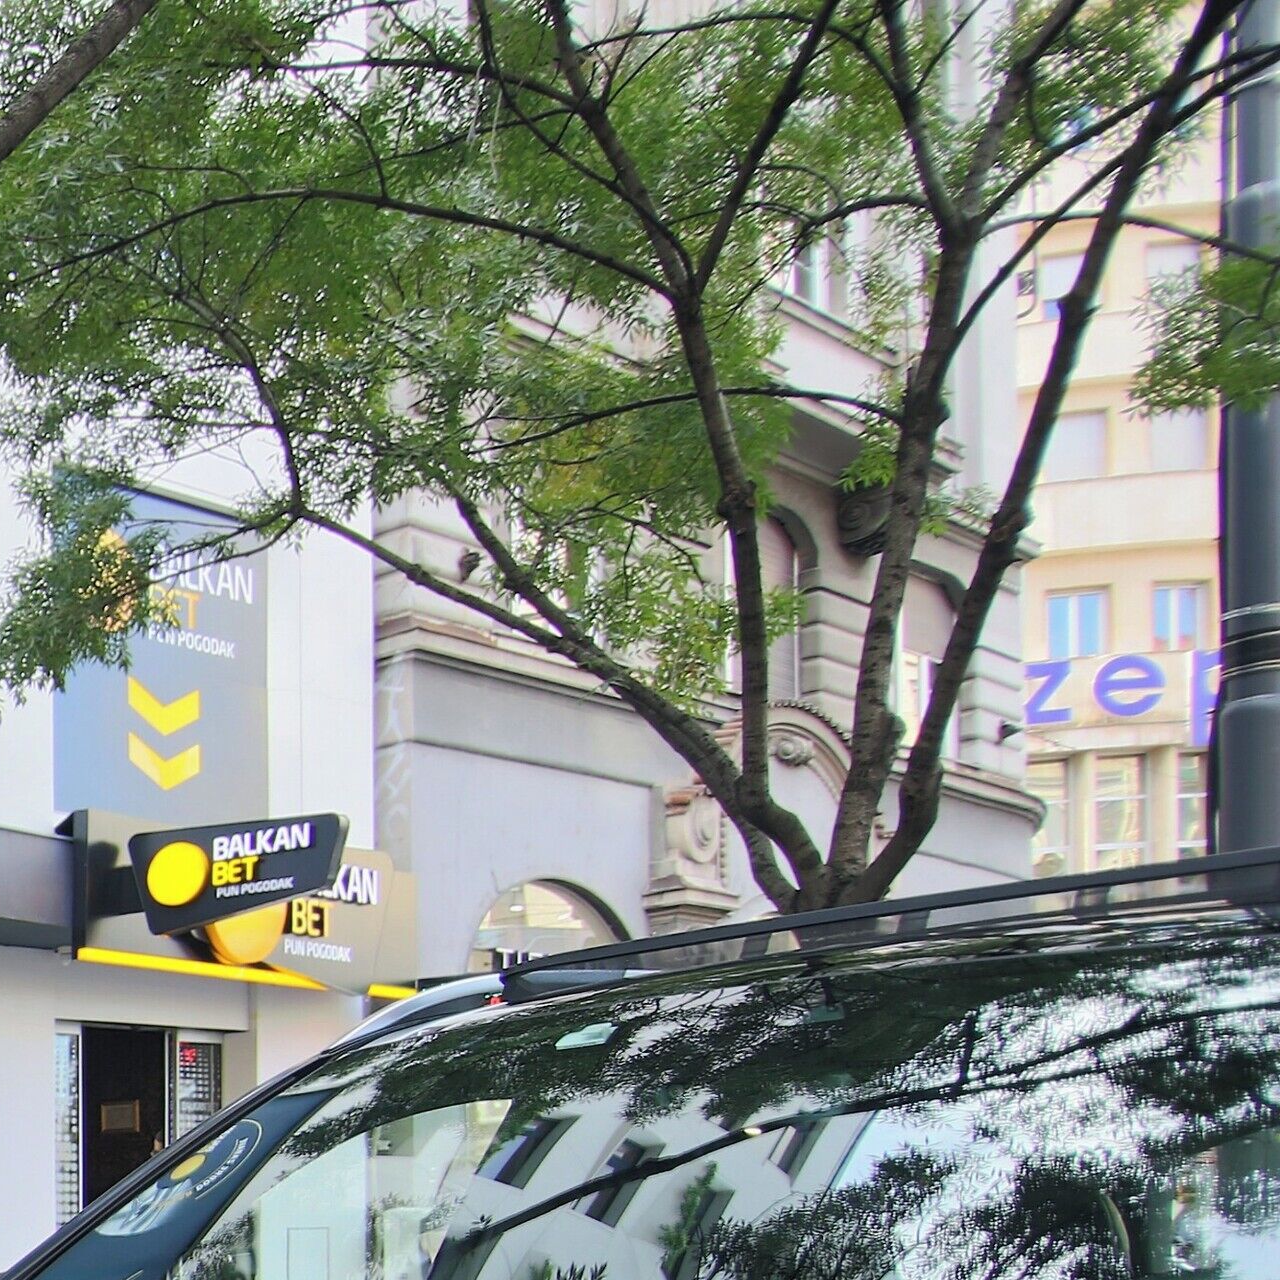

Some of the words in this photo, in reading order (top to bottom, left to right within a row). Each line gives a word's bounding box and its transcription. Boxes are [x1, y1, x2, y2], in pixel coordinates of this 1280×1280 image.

[178, 630, 236, 660] POGODAK
[212, 822, 312, 861] BALKAN
[212, 856, 259, 887] BET
[216, 884, 239, 899] PUN
[241, 877, 294, 896] POGODAK
[292, 897, 333, 938] BET
[284, 938, 306, 956] PUN
[306, 941, 352, 963] POGODAK
